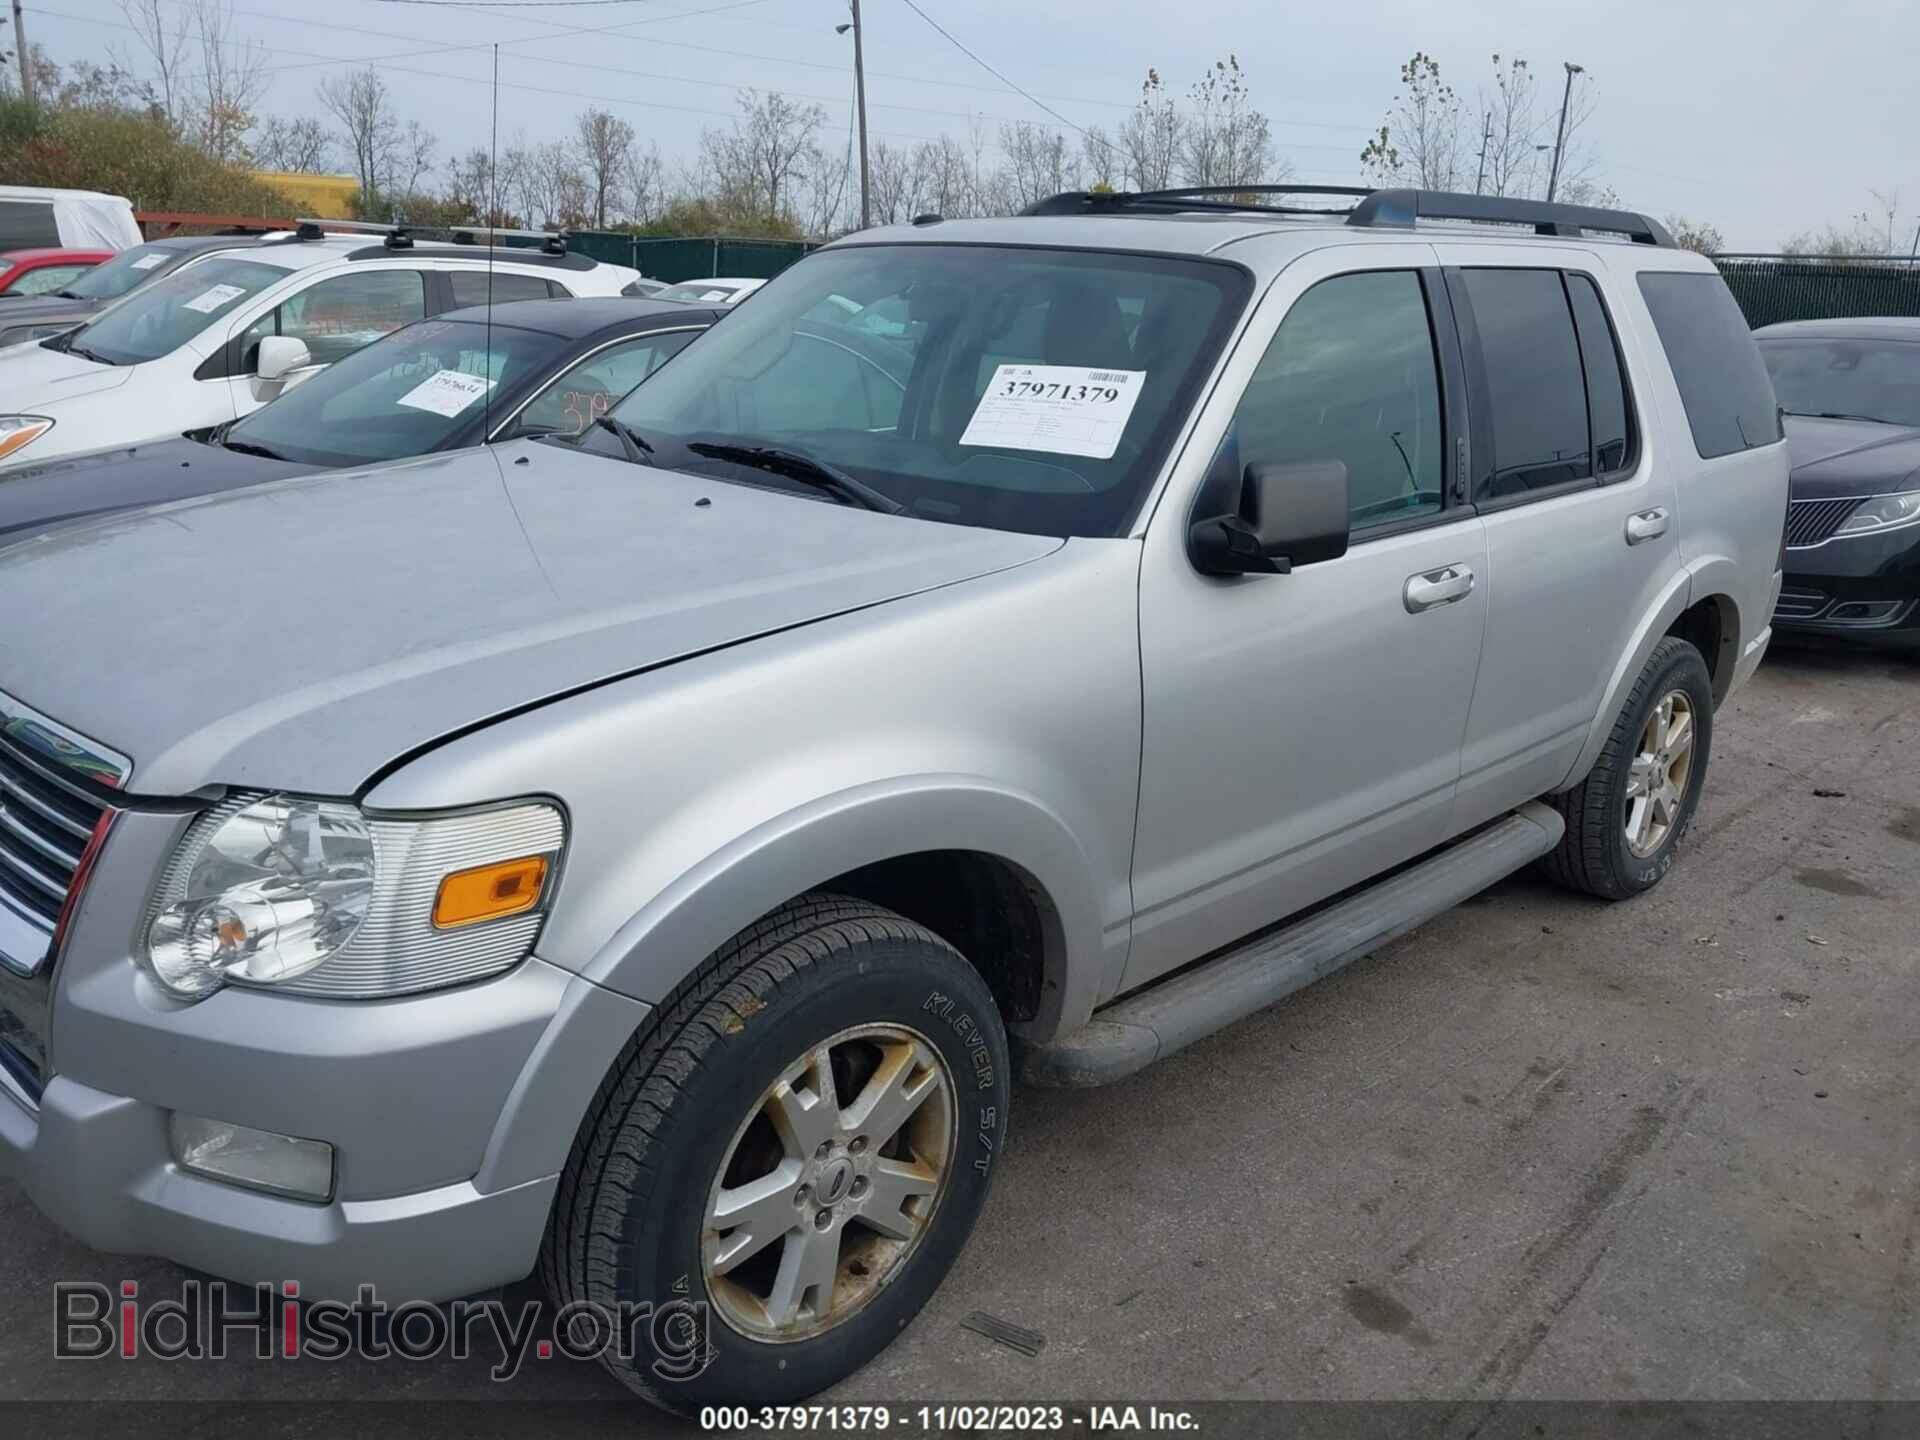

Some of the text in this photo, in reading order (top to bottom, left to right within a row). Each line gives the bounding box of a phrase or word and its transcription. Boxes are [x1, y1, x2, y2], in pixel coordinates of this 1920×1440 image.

[999, 381, 1118, 403] 37971379
[923, 991, 997, 1176] KLEVER S/T
